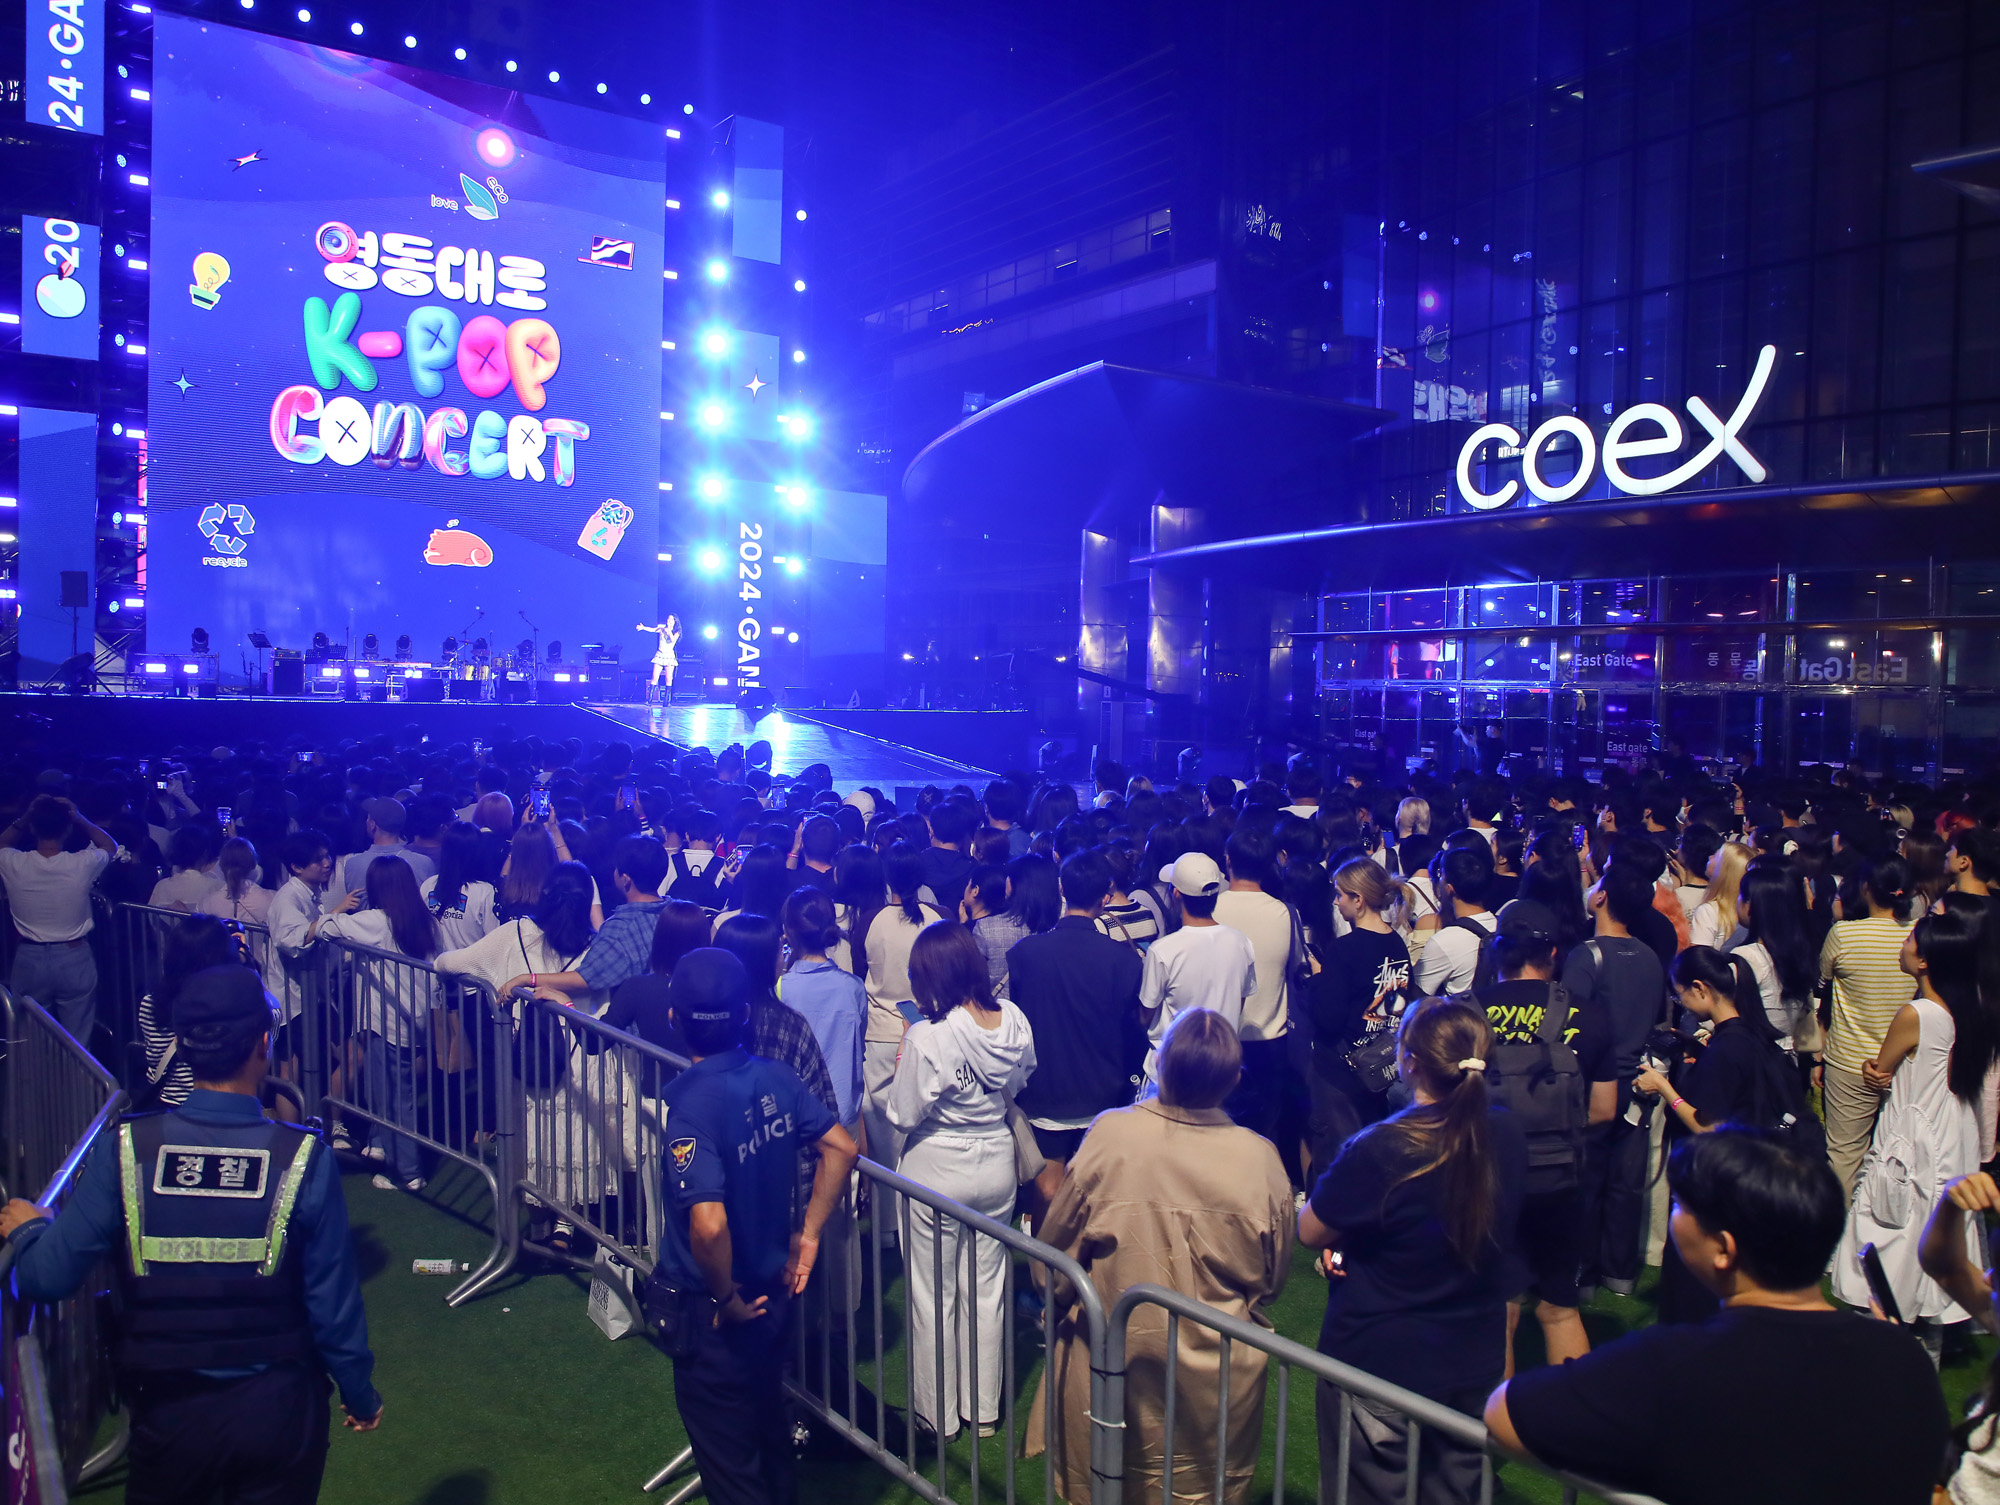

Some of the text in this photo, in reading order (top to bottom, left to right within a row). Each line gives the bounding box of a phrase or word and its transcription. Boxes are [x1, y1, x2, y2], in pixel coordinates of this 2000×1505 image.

[486, 176, 509, 205] eco
[430, 193, 459, 210] love
[315, 221, 547, 311] 영동대로
[303, 292, 561, 412] K-POP
[1456, 344, 1776, 510] coex
[202, 556, 248, 568] recycle
[1575, 653, 1633, 667] East Gate
[1607, 741, 1648, 755] East gate
[158, 1240, 251, 1260] POLICE
